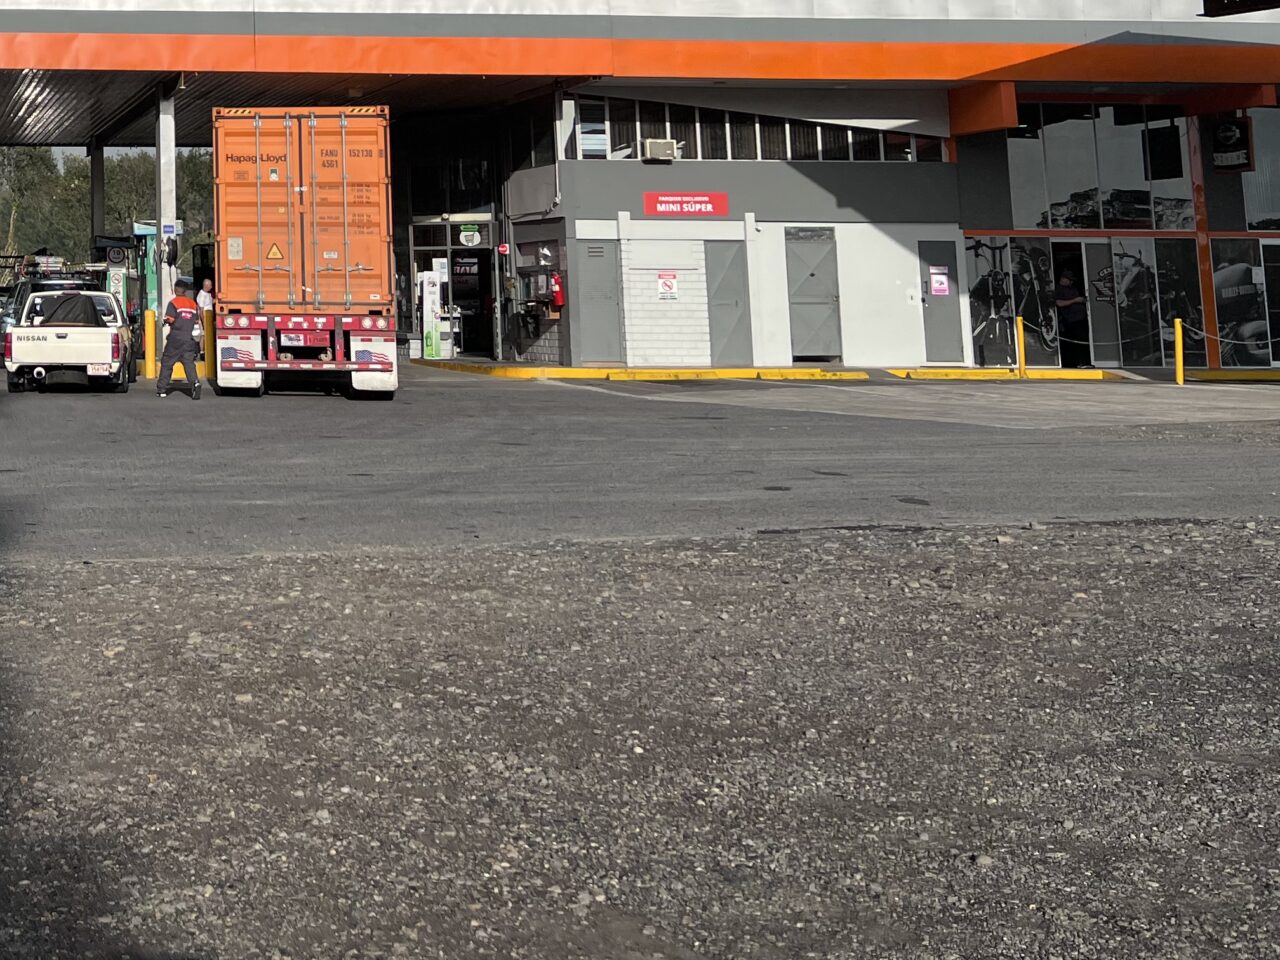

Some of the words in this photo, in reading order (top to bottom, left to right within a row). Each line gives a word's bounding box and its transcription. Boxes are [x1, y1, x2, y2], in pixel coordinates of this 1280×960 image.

[320, 148, 338, 158] FANU
[656, 203, 681, 212] MINI
[682, 201, 714, 212] SÚPER
